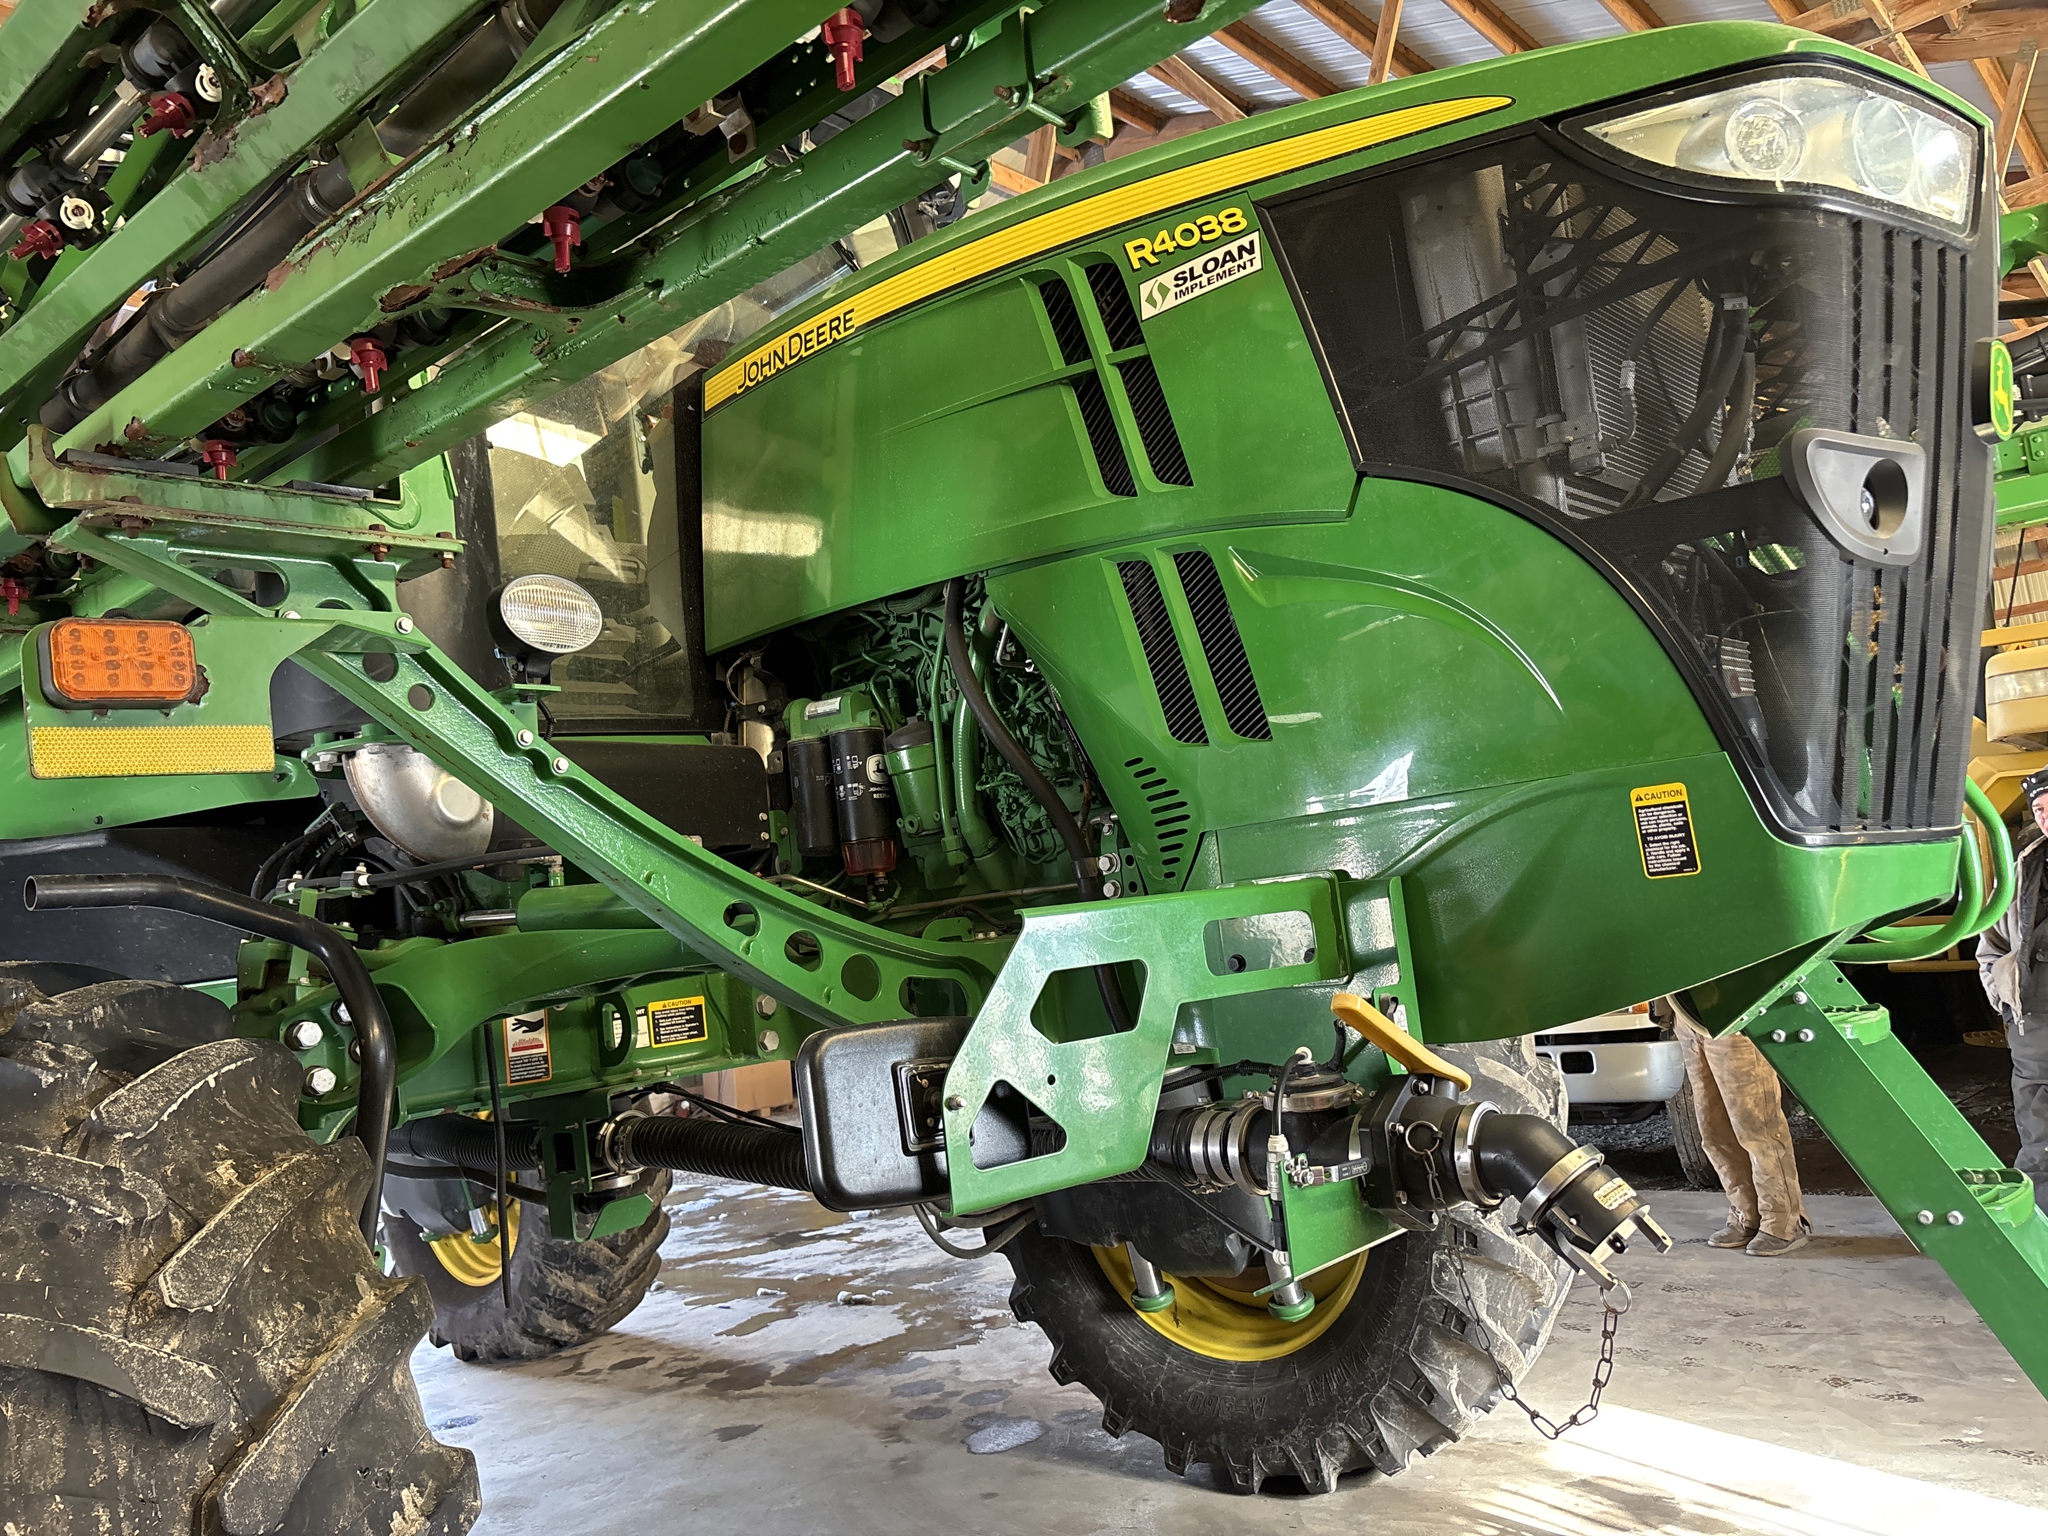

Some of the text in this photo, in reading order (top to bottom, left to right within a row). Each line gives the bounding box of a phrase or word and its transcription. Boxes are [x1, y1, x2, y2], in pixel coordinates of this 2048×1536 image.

[1124, 207, 1248, 273] R4038
[1172, 239, 1256, 290] SLOAN
[1174, 256, 1257, 301] IMPLEMENT
[737, 308, 856, 392] JOHN DEERE
[1644, 789, 1682, 800] CAUTION
[1549, 1213, 1572, 1238] BANJO
